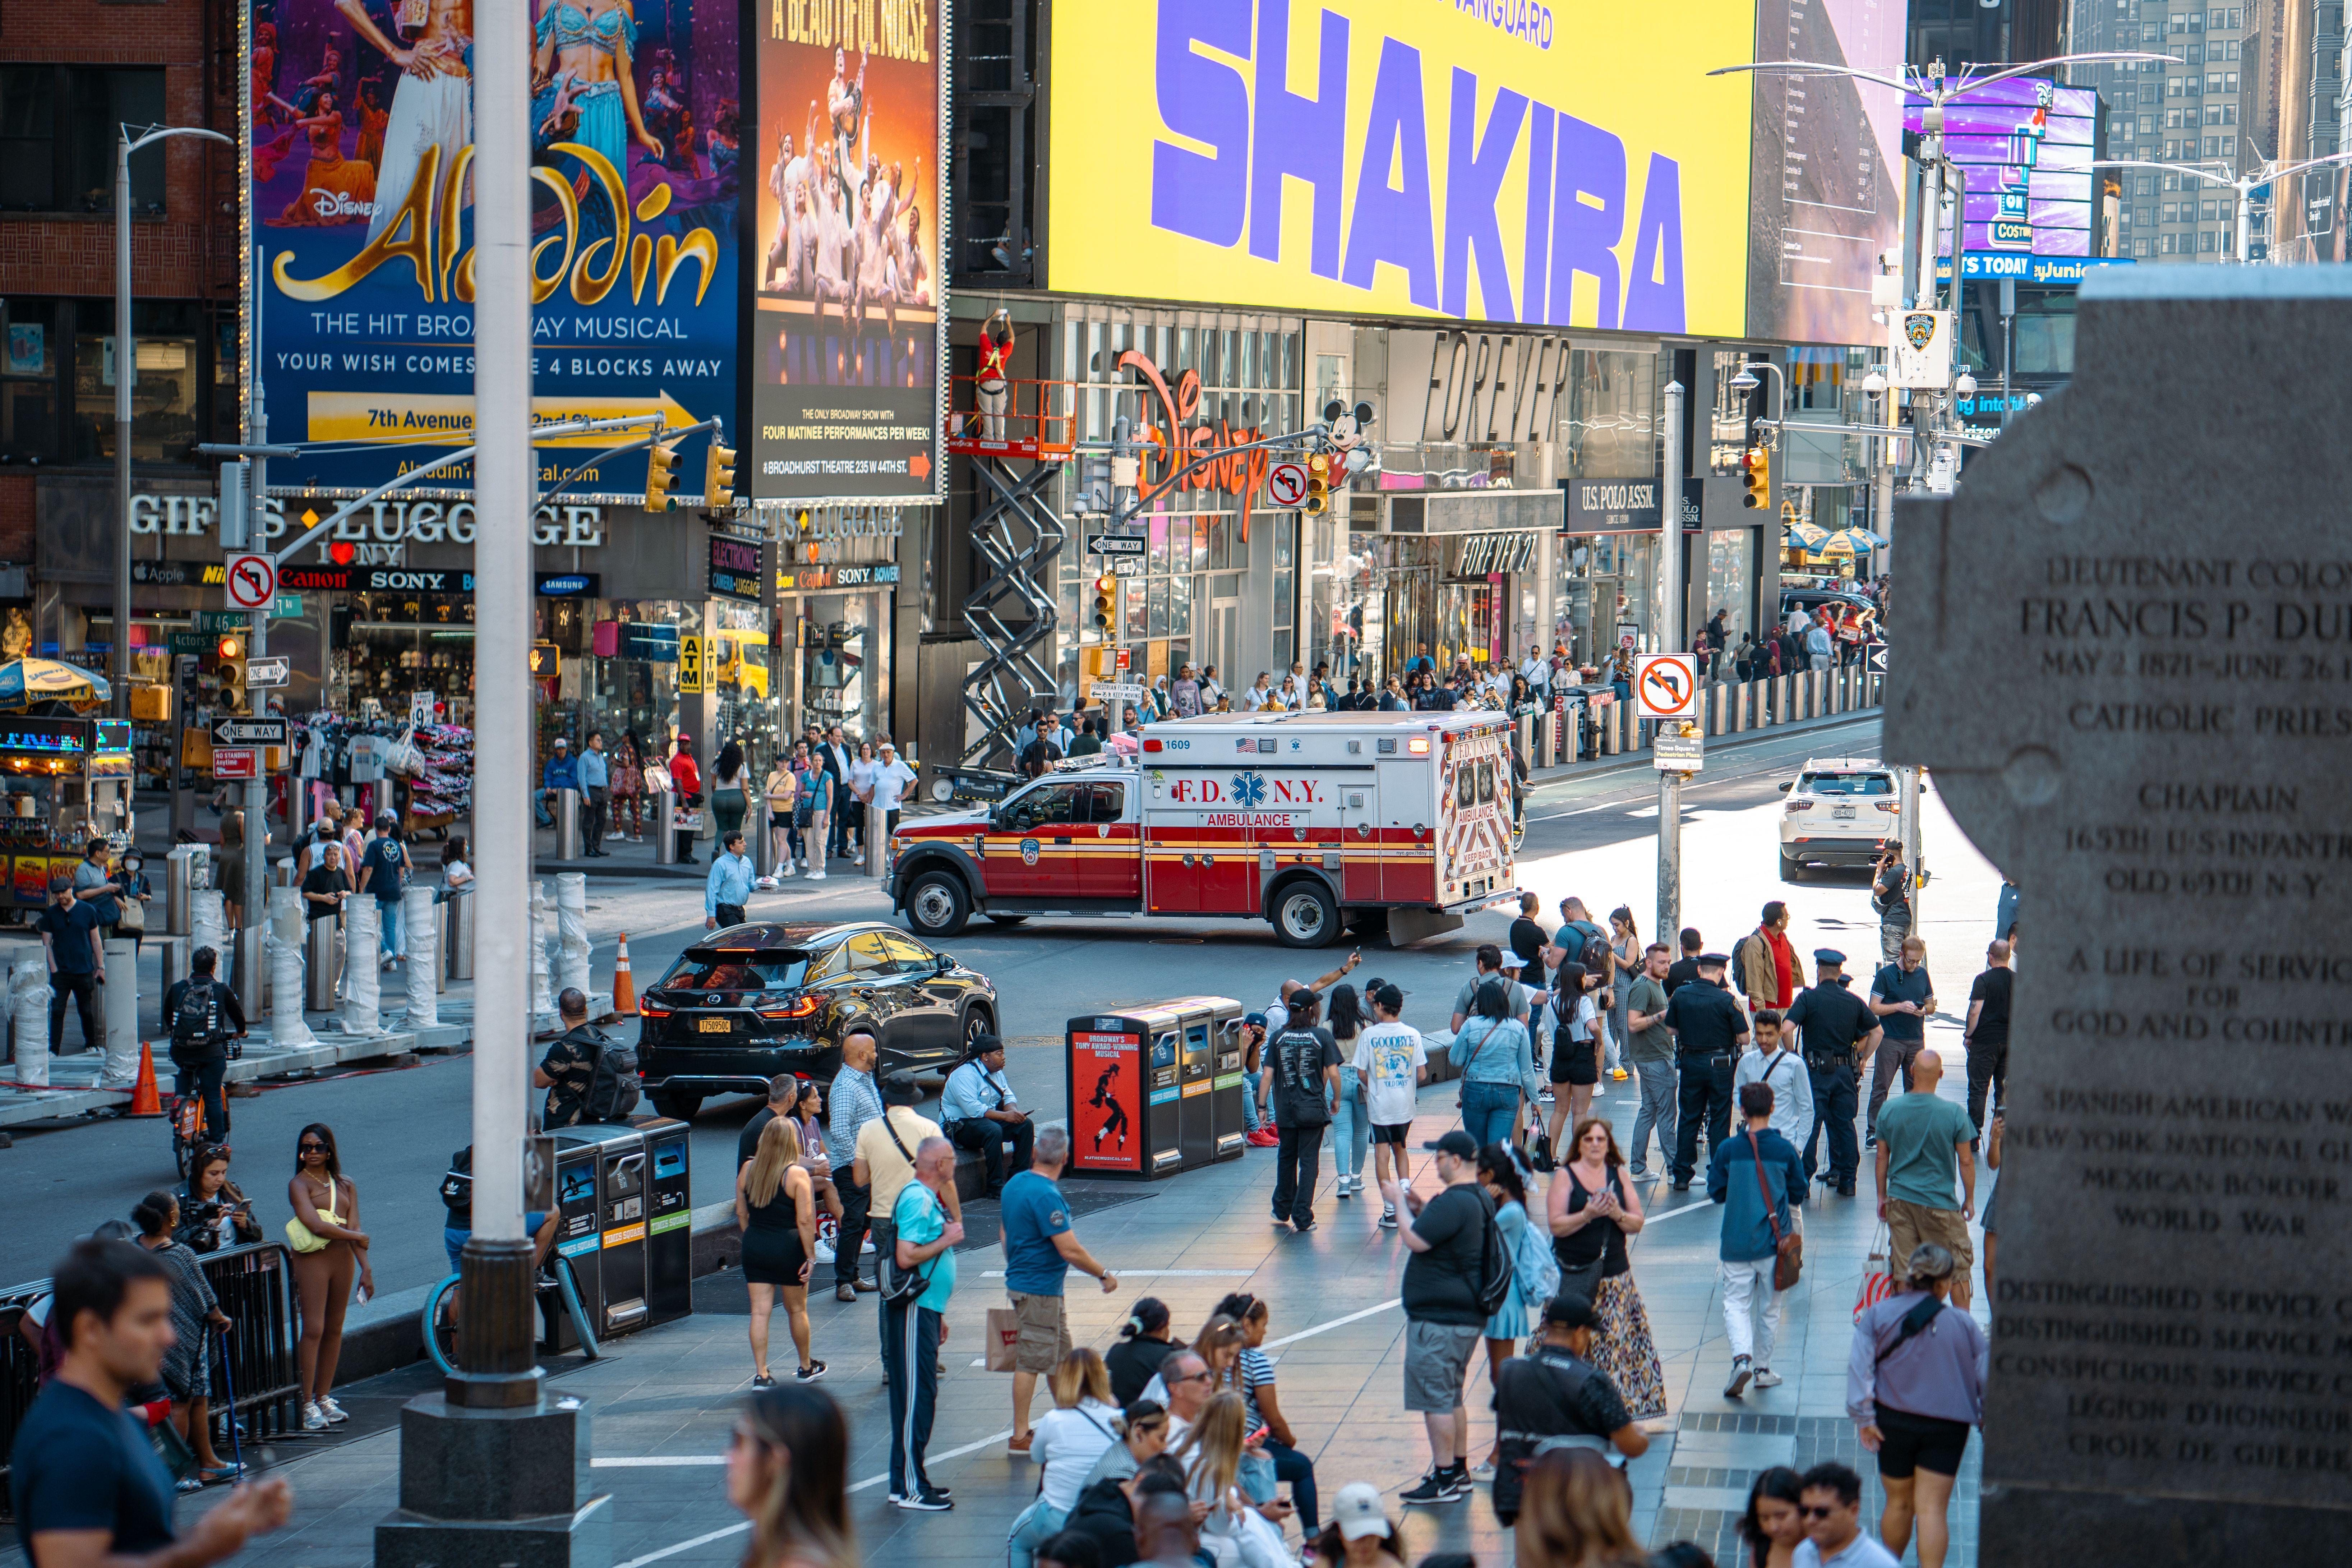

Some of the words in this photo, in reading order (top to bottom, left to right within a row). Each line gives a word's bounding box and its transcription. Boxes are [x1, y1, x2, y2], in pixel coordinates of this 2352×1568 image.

[771, 0, 783, 40] A
[787, 0, 878, 56] BEAUTIFUL
[880, 0, 929, 63] NOISE
[1152, 0, 1688, 335] SHAKIRA
[2006, 195, 2023, 209] ON
[272, 142, 719, 307] Alddin
[1983, 257, 2028, 274] TODAY
[311, 312, 359, 334] THE
[369, 313, 407, 335] HIT
[418, 314, 566, 338] BROAY
[576, 317, 688, 340] MUSICAL
[1906, 317, 1933, 326] DEPARTMENT
[277, 352, 333, 371] YOUR
[343, 355, 396, 372] WISH
[406, 356, 475, 373] COMES
[549, 359, 561, 375] 4
[572, 359, 652, 376] BLOCKS
[663, 360, 721, 377] AWAY
[1421, 330, 1572, 442] FOREVER
[368, 409, 398, 428] 7th
[403, 410, 472, 429] Avenue
[802, 409, 814, 420] THE
[815, 409, 829, 420] ONLY
[830, 410, 861, 420] BROADWAY
[862, 410, 879, 420] SHOW
[880, 410, 894, 421] WITH
[763, 425, 786, 440] FOUR
[787, 426, 823, 440] MATINEE
[824, 426, 888, 441] PERFORMANCES
[889, 427, 905, 441] PER
[905, 427, 930, 441] WEEK!
[768, 460, 820, 475] BROADHURST
[821, 460, 855, 474] THEATRE
[855, 460, 869, 474] 235
[870, 461, 877, 473] W
[877, 460, 895, 473] 44TH
[896, 461, 907, 473] ST.
[1582, 486, 1599, 511] U.S.
[1600, 485, 1627, 510] POLO
[1627, 485, 1655, 509] ASSN.
[332, 500, 601, 547] LUGGGE
[812, 506, 903, 539] LUGGAGE
[1606, 515, 1618, 524] SINCE
[1619, 514, 1629, 524] 1890
[355, 542, 403, 567] NY
[1097, 541, 1113, 549] ONE
[1121, 541, 1138, 550] WAY
[1457, 535, 1521, 577] FOREVER
[1518, 532, 1538, 572] 21
[712, 540, 761, 574] ELECTRONICS
[149, 567, 185, 583] Apple
[277, 569, 347, 589] Canon
[370, 571, 444, 590] SONY
[545, 580, 583, 590] SAMSUNG
[799, 570, 831, 589] Canon
[837, 568, 871, 585] SONY
[874, 567, 899, 582] BOWER
[277, 599, 282, 615] 7
[202, 615, 211, 631] W
[215, 615, 229, 631] 46
[2020, 597, 2208, 638] FRANCIS
[175, 635, 209, 646] Actors'
[681, 639, 698, 684] ATM
[250, 667, 262, 679] ONE
[269, 666, 283, 677] WAY
[1554, 696, 1564, 753] CHICAGO
[2068, 702, 2236, 733] CATHOLIC
[222, 725, 244, 737] ONE
[254, 726, 276, 737] WAY
[1165, 740, 1190, 750] 1609
[1459, 743, 1471, 759] F.D.
[1480, 739, 1491, 755] N.Y.
[1177, 780, 1226, 803] F.D.
[1273, 780, 1324, 803] N.Y.
[2137, 784, 2300, 813] CHAPLAIN
[1207, 814, 1291, 826] AMBULANCE
[1458, 804, 1493, 825] AMBULANCE
[1464, 852, 1477, 863] KEEP
[1478, 848, 1492, 861] BACK
[2104, 868, 2170, 895] OLD
[2066, 947, 2089, 974] A
[2105, 949, 2169, 977] LIFE
[2180, 951, 2225, 978] OF
[2187, 987, 2239, 1007] FOR
[702, 1021, 729, 1030] T750950C
[2051, 1008, 2129, 1037] GOD
[2137, 1011, 2209, 1041] AND
[1075, 1042, 1090, 1050] TONY
[1091, 1042, 1138, 1051] AWARD-WINNING
[1276, 1030, 1322, 1048] METALLICA
[1371, 1036, 1415, 1048] GOODBYE
[1183, 1085, 1195, 1095] TIMES
[1196, 1082, 1212, 1093] SQUARE
[1215, 1078, 1227, 1087] TIMES
[1227, 1074, 1242, 1084] SQUARE
[1150, 1093, 1162, 1103] TIMES
[1162, 1090, 1179, 1100] SQUARE
[651, 1219, 669, 1232] TIMES
[669, 1214, 690, 1227] SQUARE
[2241, 1209, 2307, 1237] WAR
[577, 1237, 598, 1251] SQUARE
[605, 1232, 622, 1245] TIMES
[623, 1226, 644, 1240] SQUARE
